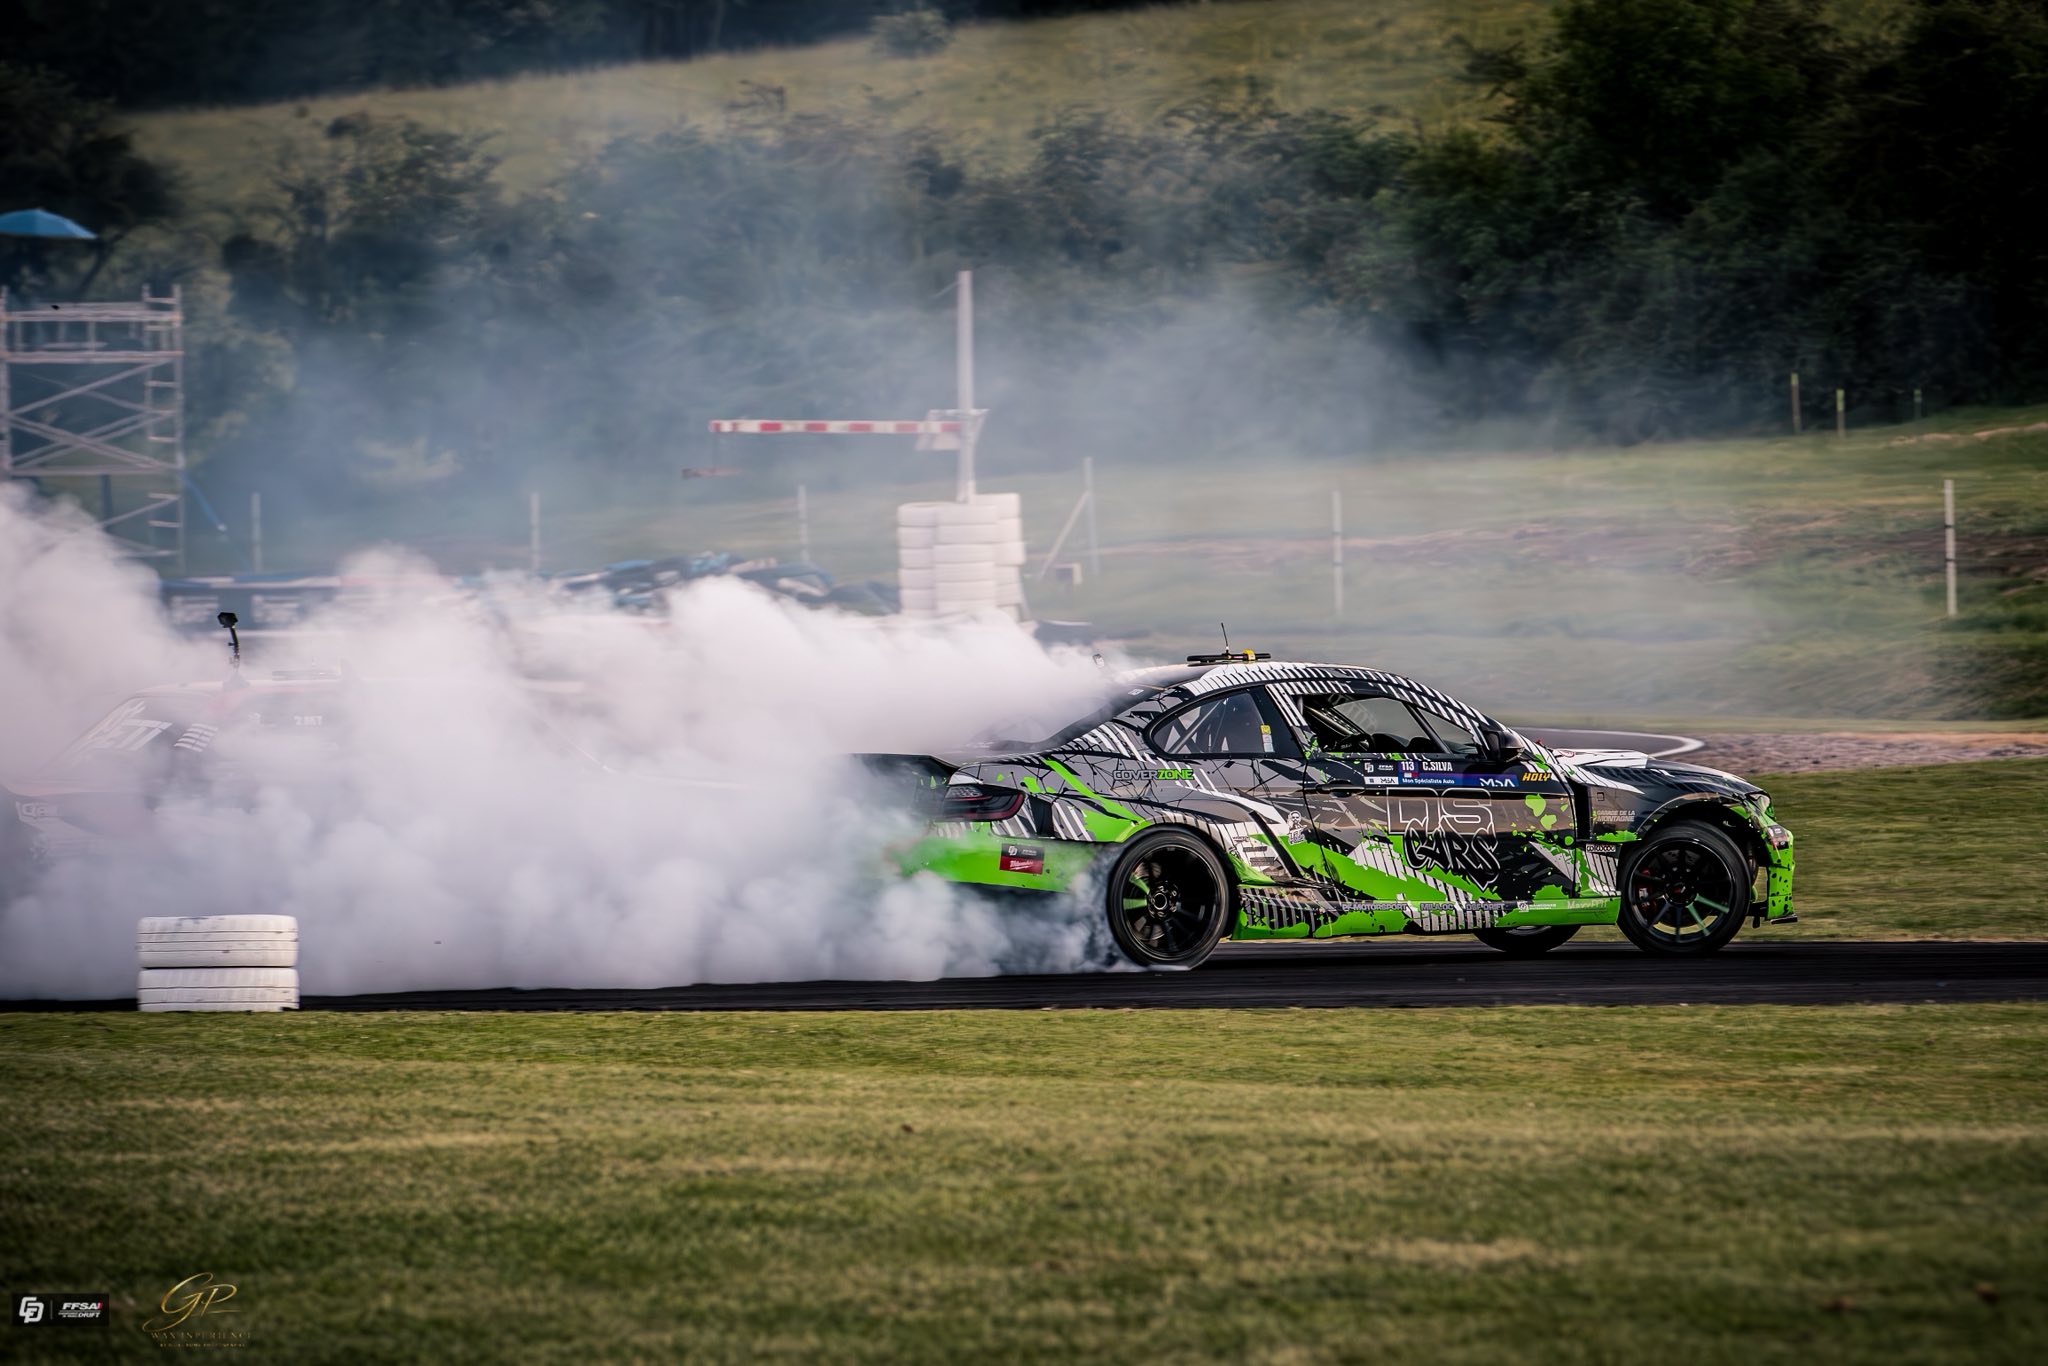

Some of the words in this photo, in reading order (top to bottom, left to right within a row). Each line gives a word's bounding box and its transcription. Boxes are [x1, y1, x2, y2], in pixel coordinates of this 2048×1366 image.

[1401, 761, 1415, 771] 113
[1422, 761, 1453, 772] C.SILVA
[1112, 769, 1194, 780] COVERZONE
[1522, 772, 1551, 782] HOLY
